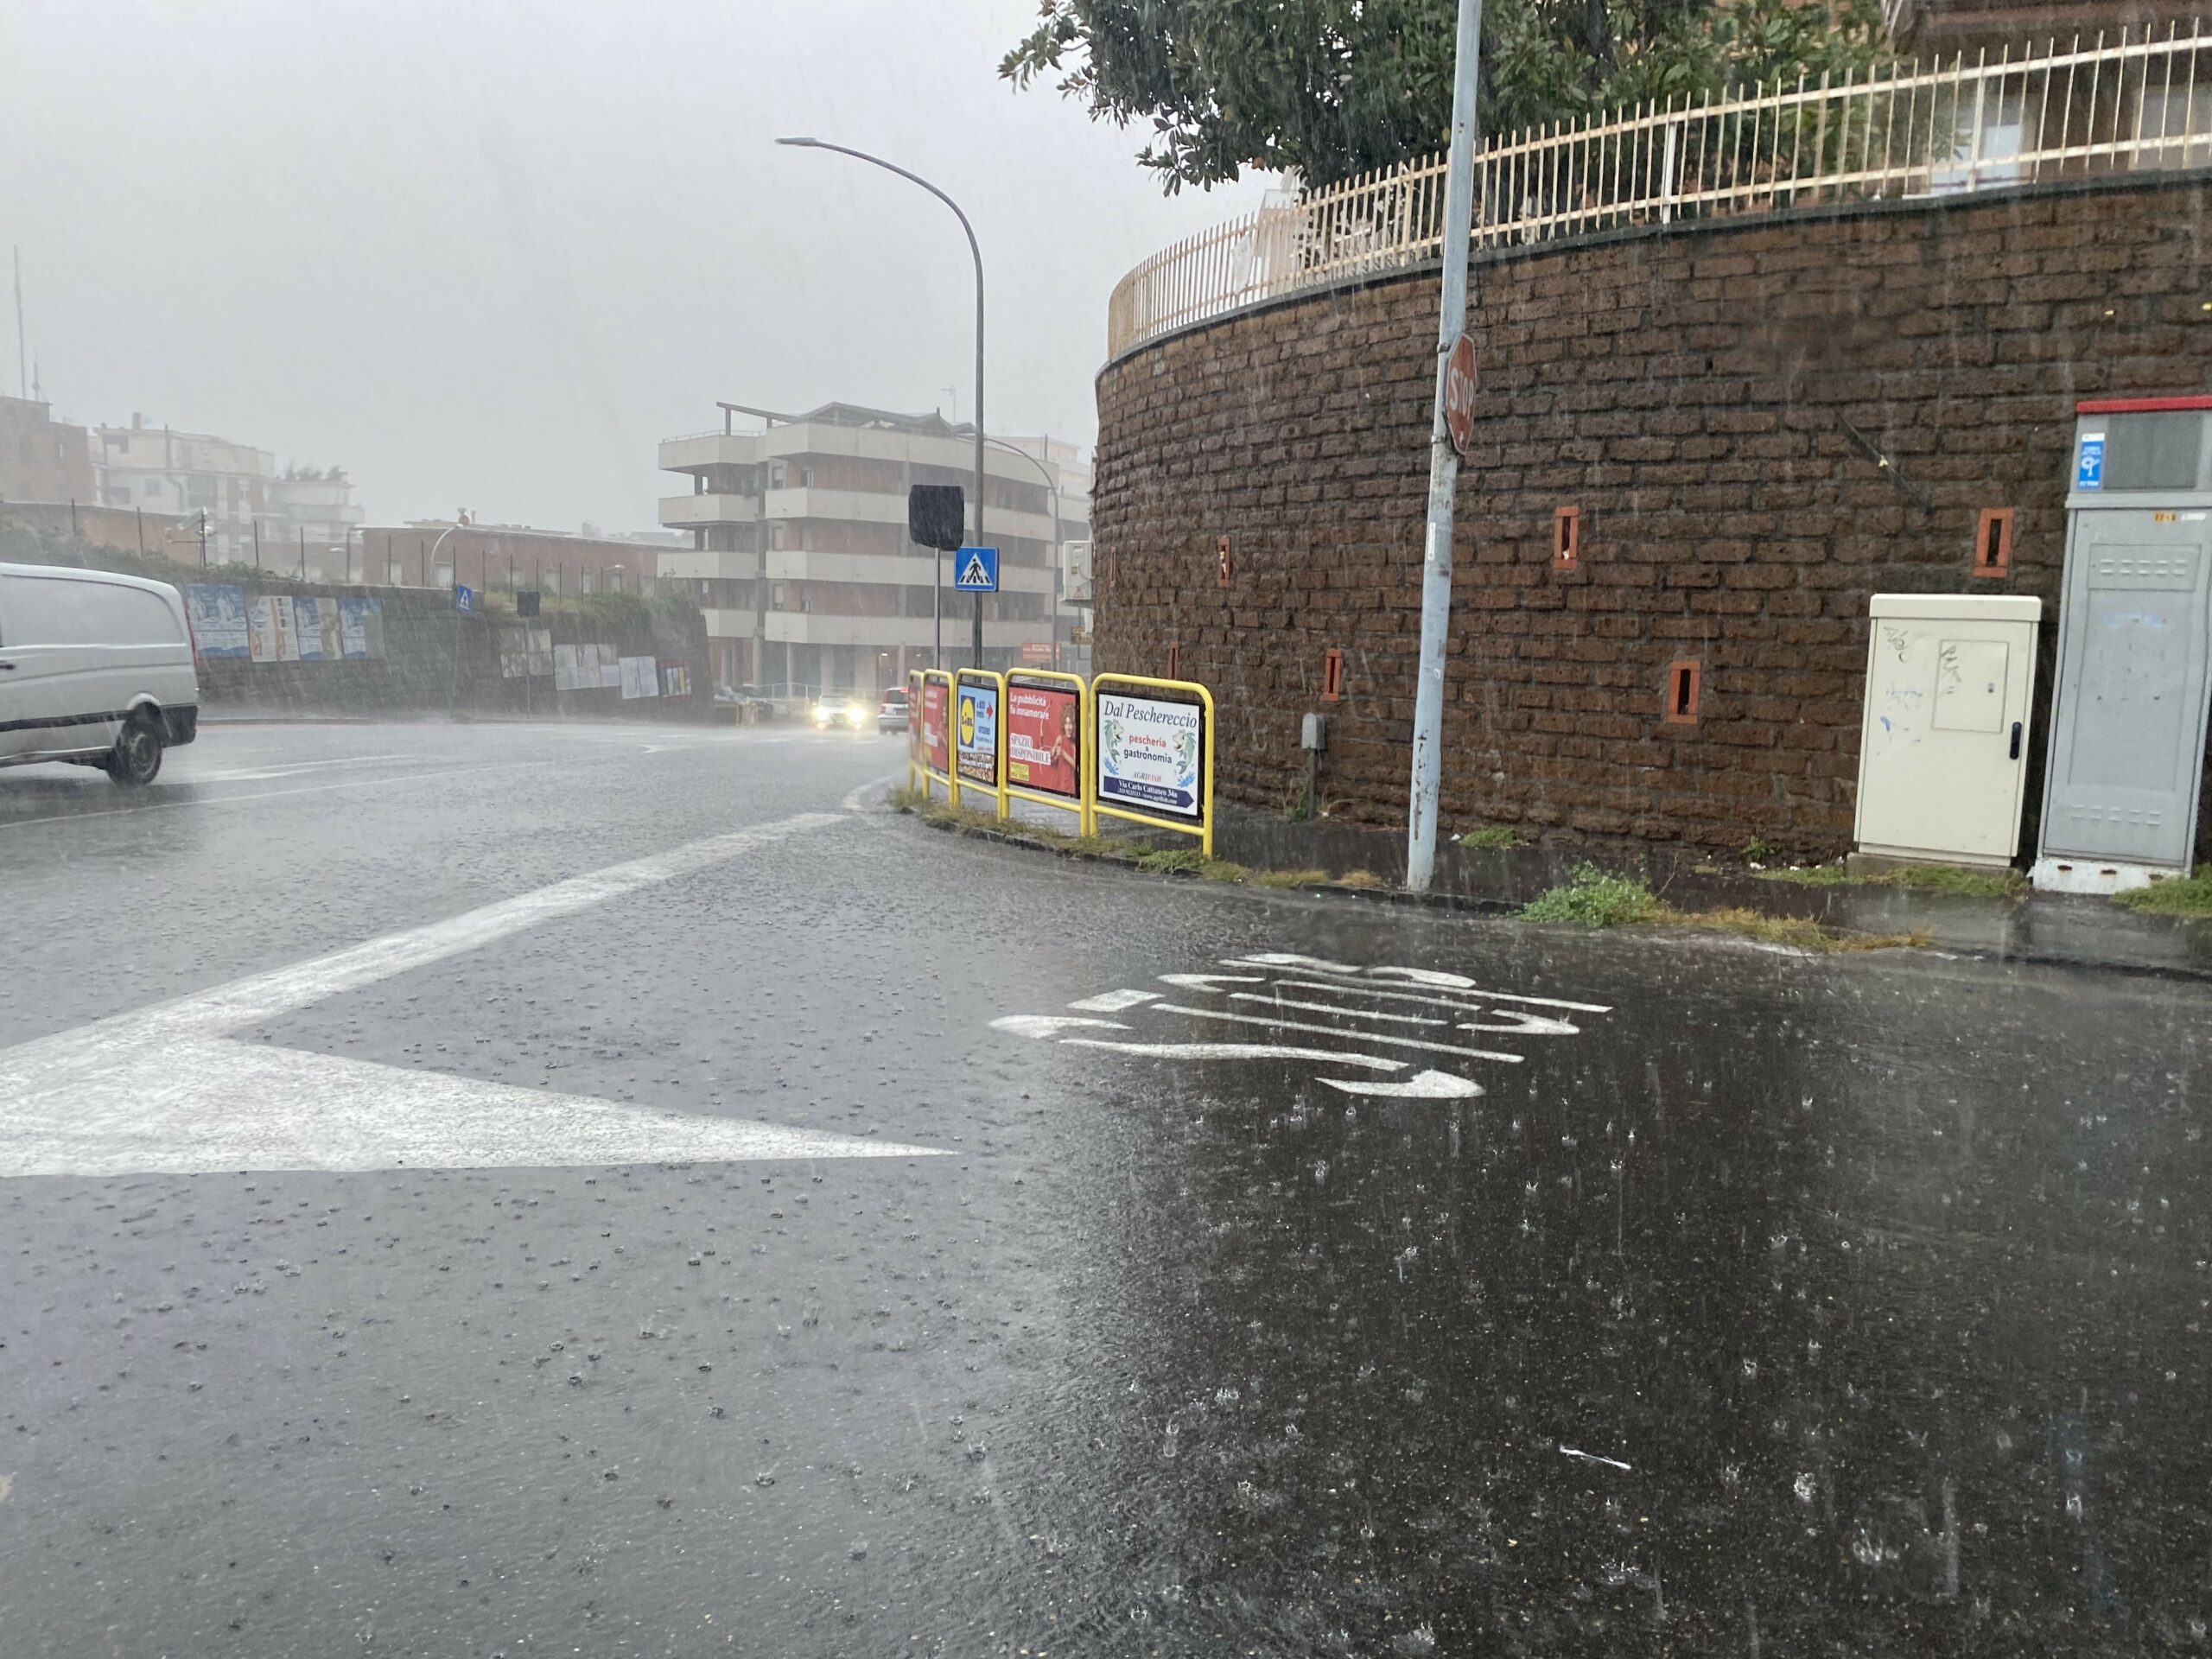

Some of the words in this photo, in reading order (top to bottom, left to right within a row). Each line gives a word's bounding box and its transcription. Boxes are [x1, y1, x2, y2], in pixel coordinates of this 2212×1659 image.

[1449, 366, 1474, 420] STOP
[1010, 692, 1017, 702] La
[1017, 694, 1046, 707] pubblicità
[1010, 704, 1015, 715] fa
[1016, 707, 1049, 720] innamorare
[1103, 701, 1124, 717] Dal
[1126, 703, 1198, 728] Peschereccio
[1011, 734, 1033, 747] SPAZIO
[1128, 734, 1166, 748] pescheria
[1011, 746, 1051, 764] DISPONIBILE
[1123, 748, 1173, 764] gastronomia
[1133, 772, 1162, 783] AGRIFISH
[1118, 779, 1128, 789] Via
[1128, 781, 1143, 791] Carlo
[1142, 784, 1166, 797] Cattaneo
